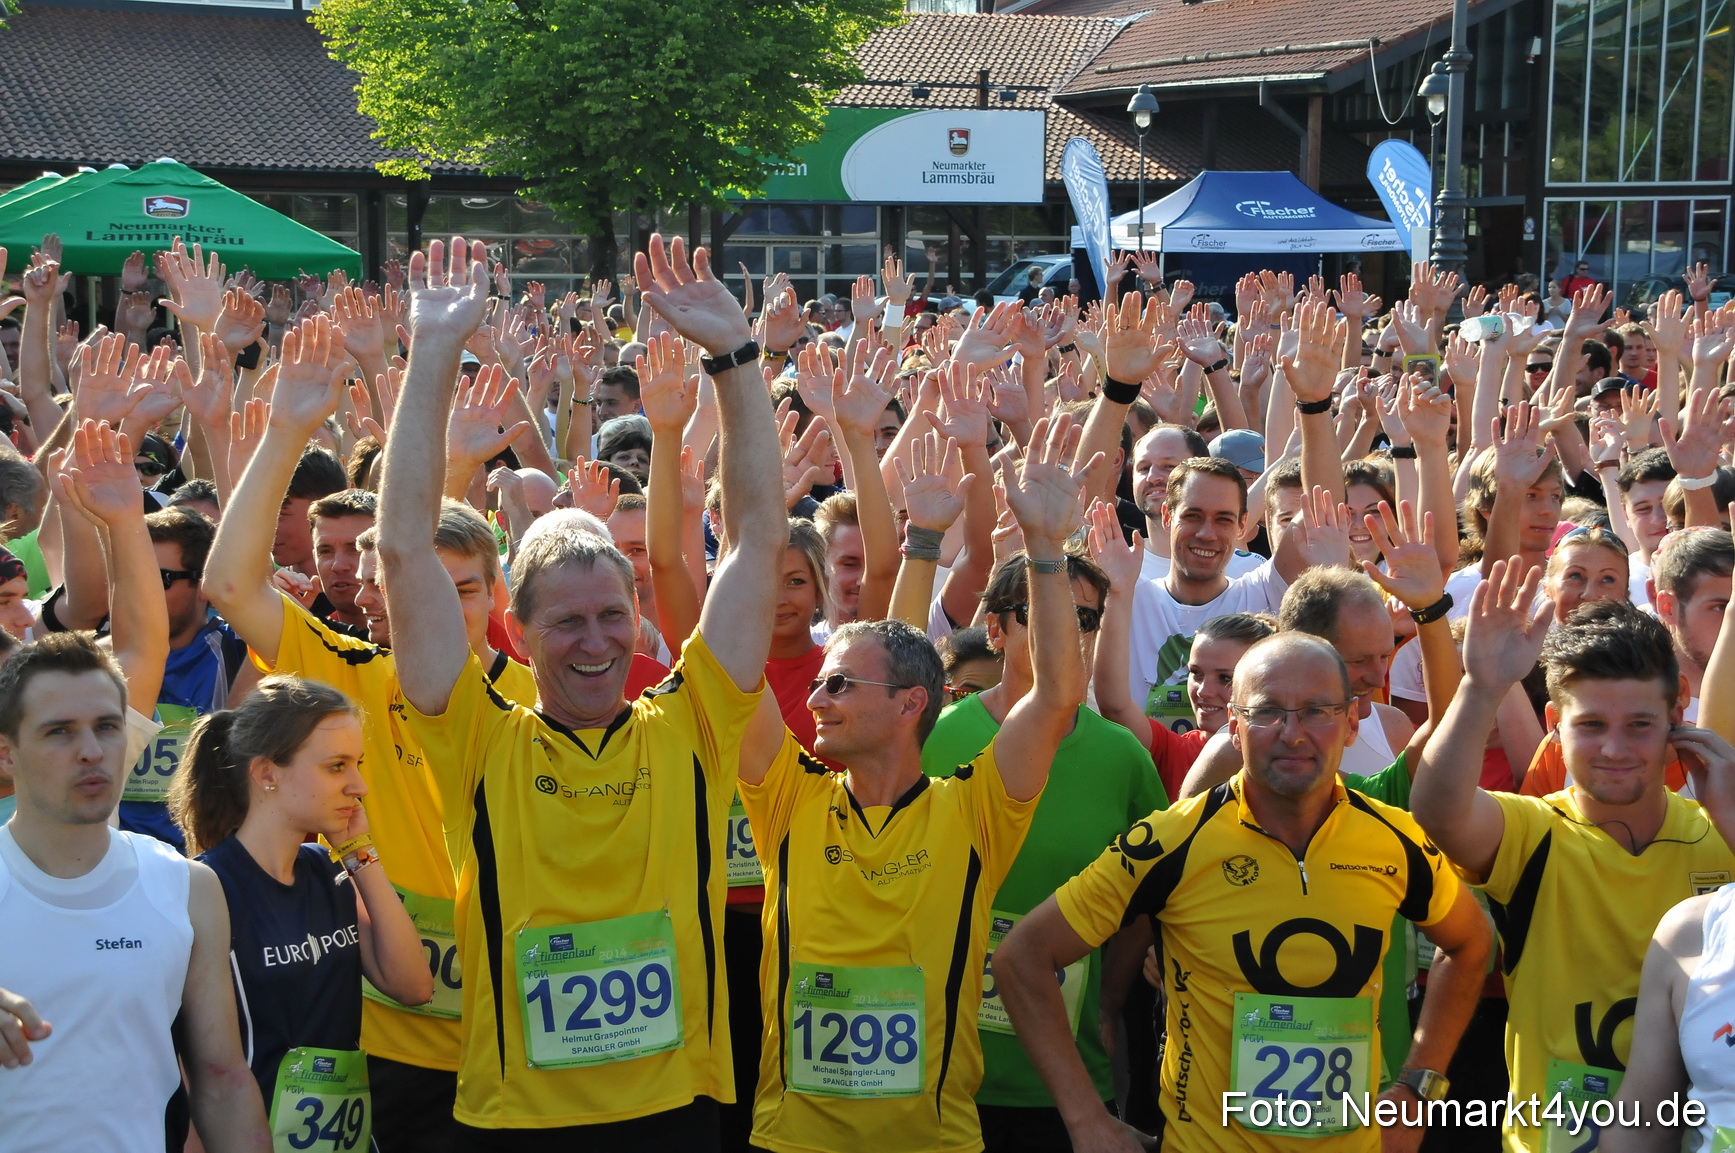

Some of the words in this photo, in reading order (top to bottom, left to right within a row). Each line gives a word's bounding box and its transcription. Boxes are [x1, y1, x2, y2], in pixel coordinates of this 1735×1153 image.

[932, 161, 986, 170] Neumarkter
[922, 171, 995, 185] Lammsbräu
[1251, 206, 1316, 216] Fischer
[109, 223, 225, 234] Neumarkter
[86, 231, 245, 246] Lammsbräu
[1197, 239, 1227, 247] Fischer
[729, 860, 756, 869] Christina
[843, 849, 929, 880] SNGLER
[1330, 862, 1368, 871] Deutsche
[1368, 865, 1383, 873] Post
[96, 937, 142, 950] Stefan
[540, 945, 597, 962] firmenlauf
[526, 963, 672, 1033] 1299
[807, 985, 851, 998] firmenlauf
[982, 1002, 1003, 1012] Claus
[985, 1013, 997, 1021] des
[1258, 1017, 1313, 1031] firmenlauf
[561, 1034, 593, 1044] Helmut
[594, 1025, 648, 1041] Graspointner
[794, 1010, 918, 1065] 1298
[571, 1043, 616, 1055] SPANGLER
[617, 1038, 641, 1049] GmbH
[812, 1065, 839, 1075] Michael
[839, 1068, 895, 1078] Spangler-Lang
[1252, 1045, 1352, 1101] 228
[822, 1077, 859, 1087] SPANGLER
[1312, 1105, 1331, 1113] Reindl
[288, 1097, 364, 1152] 349
